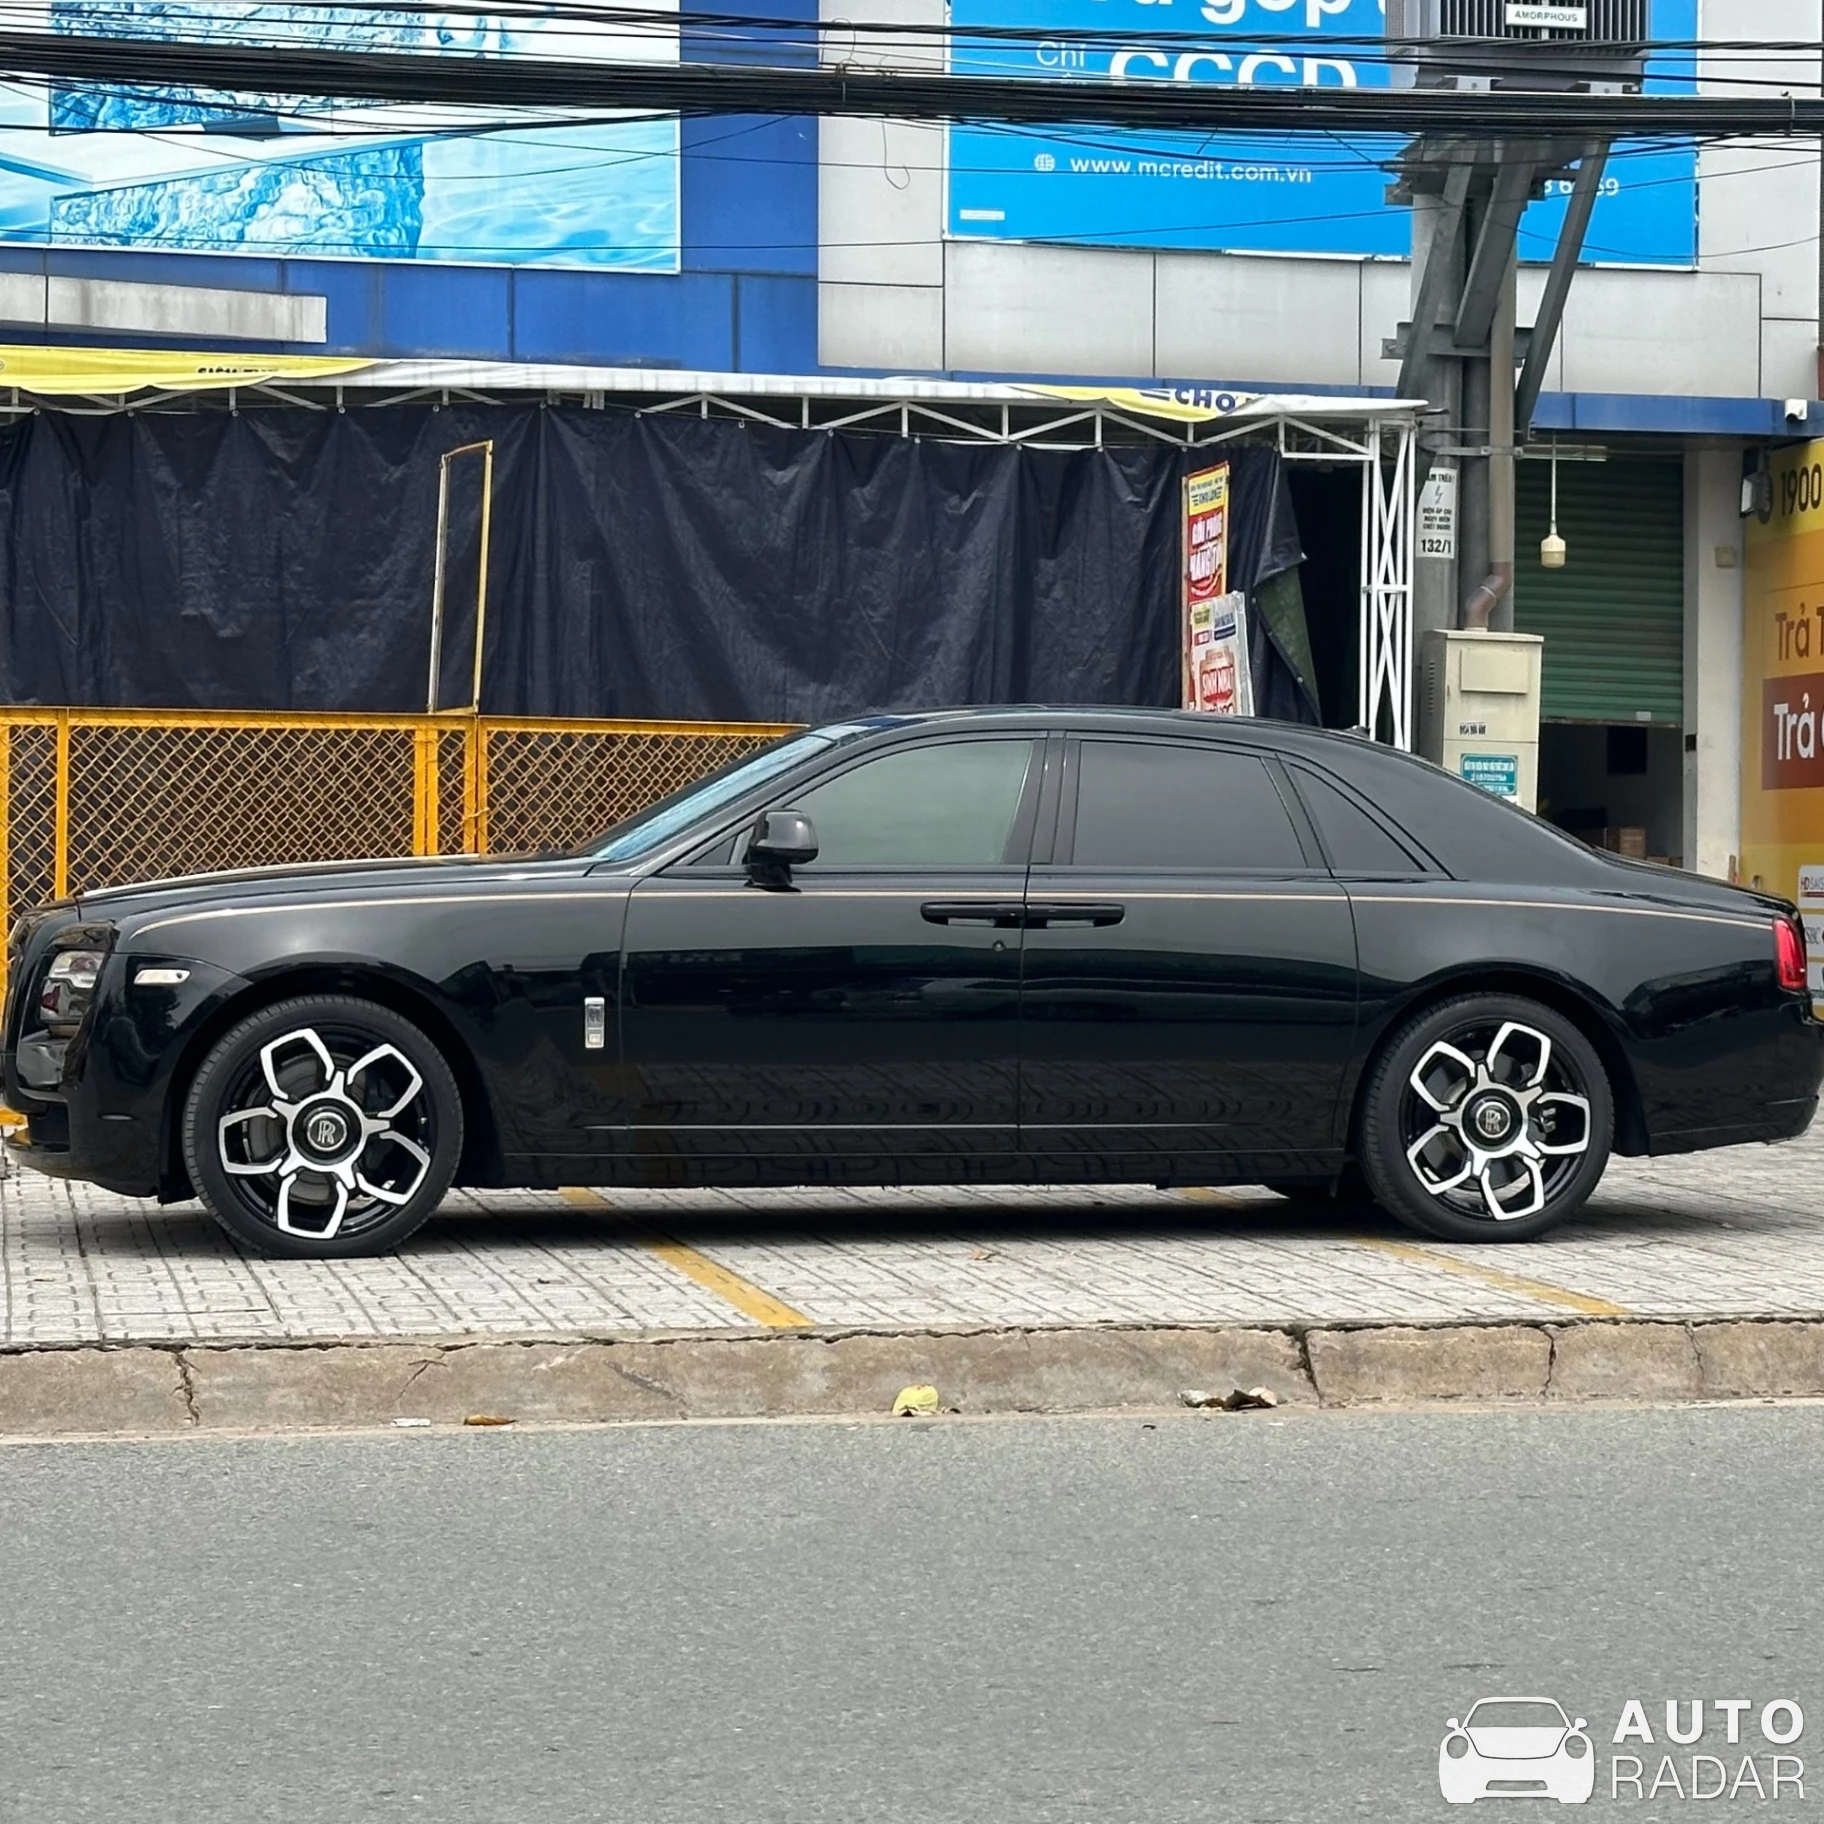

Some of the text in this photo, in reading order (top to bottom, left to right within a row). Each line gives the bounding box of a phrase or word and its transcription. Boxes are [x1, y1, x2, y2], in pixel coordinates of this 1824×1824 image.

[1514, 10, 1578, 22] AMORPHOUS
[1070, 156, 1312, 183] www.mcredit.com.vn
[1421, 538, 1451, 553] 132/1
[1775, 601, 1810, 661] Trả
[1774, 692, 1815, 760] Trả
